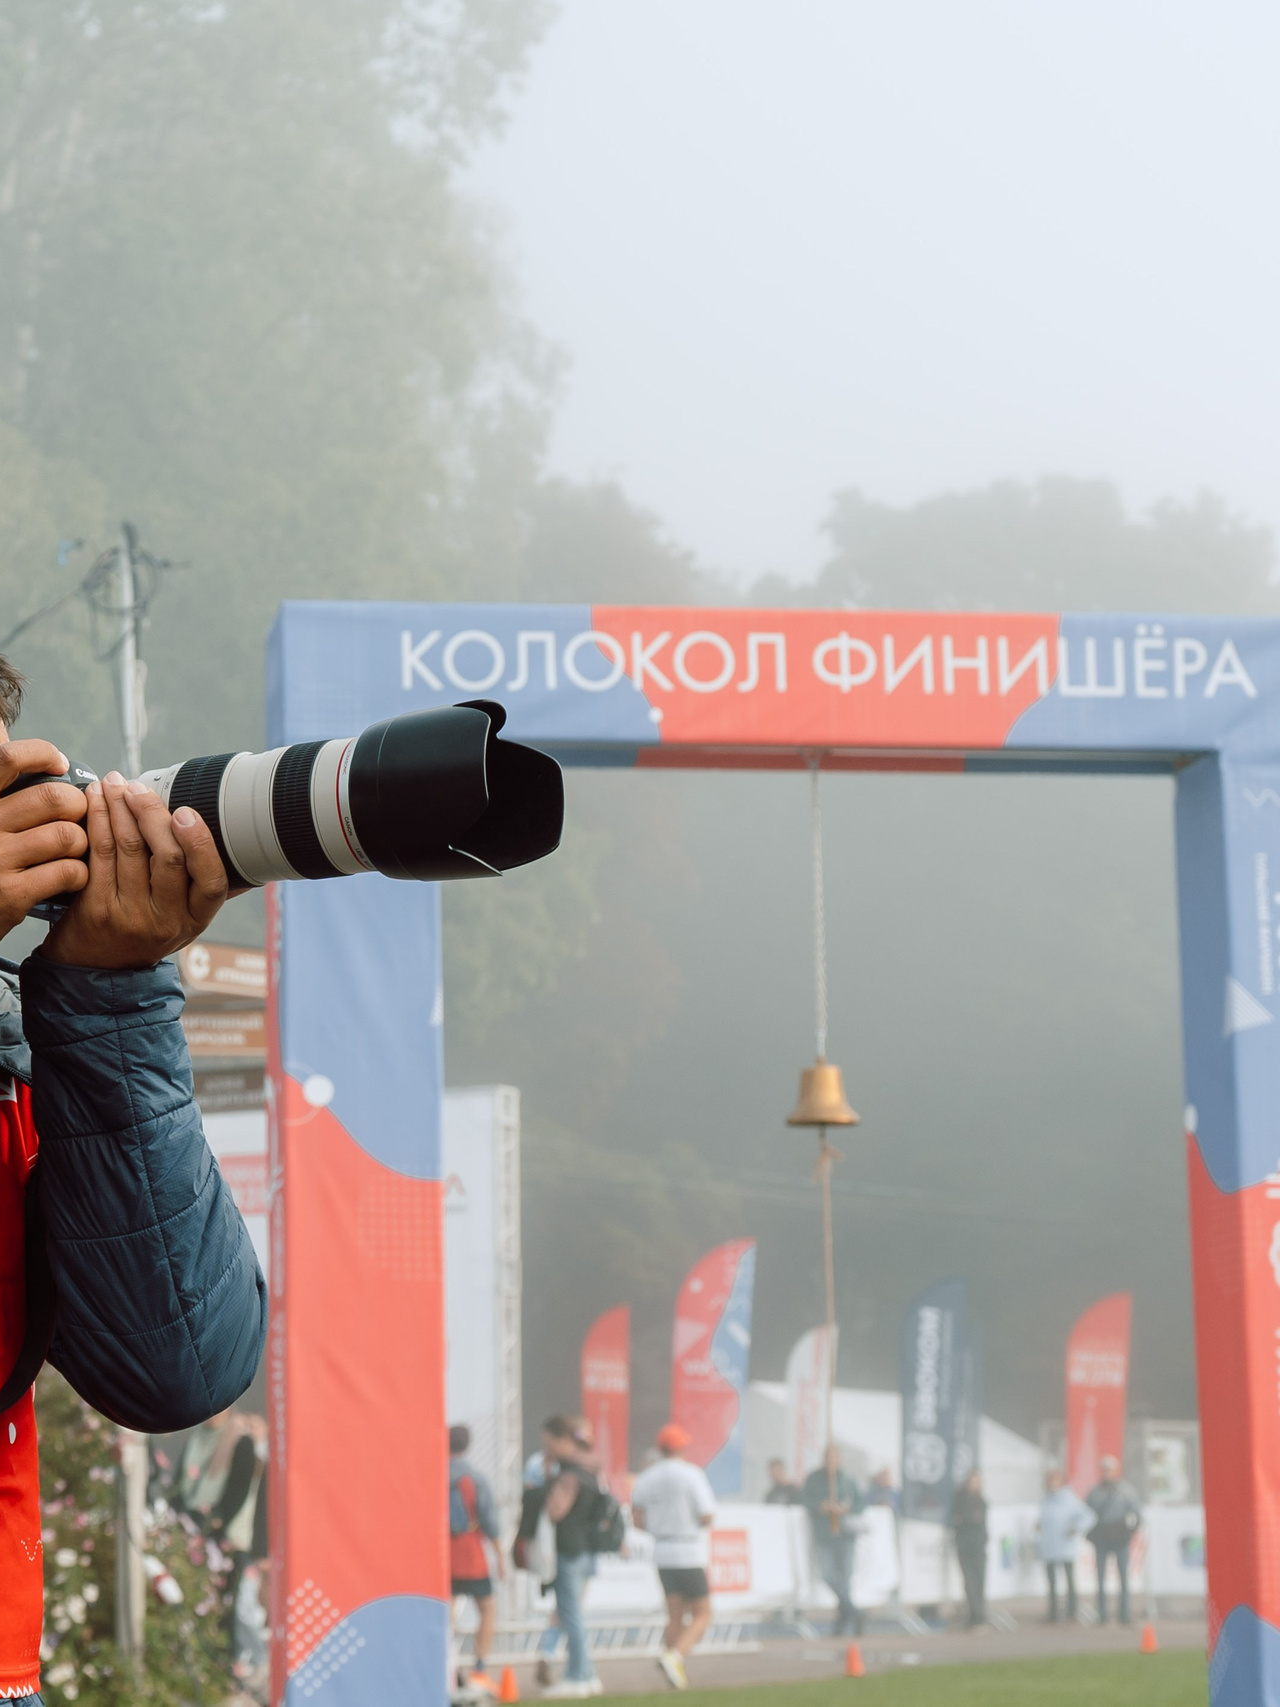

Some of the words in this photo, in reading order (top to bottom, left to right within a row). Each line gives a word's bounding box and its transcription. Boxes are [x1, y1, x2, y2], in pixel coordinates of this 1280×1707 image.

[401, 629, 787, 693] КОЛОКОЛ
[811, 623, 1258, 699] ФИНИШЁРА
[344, 816, 353, 836] CANON
